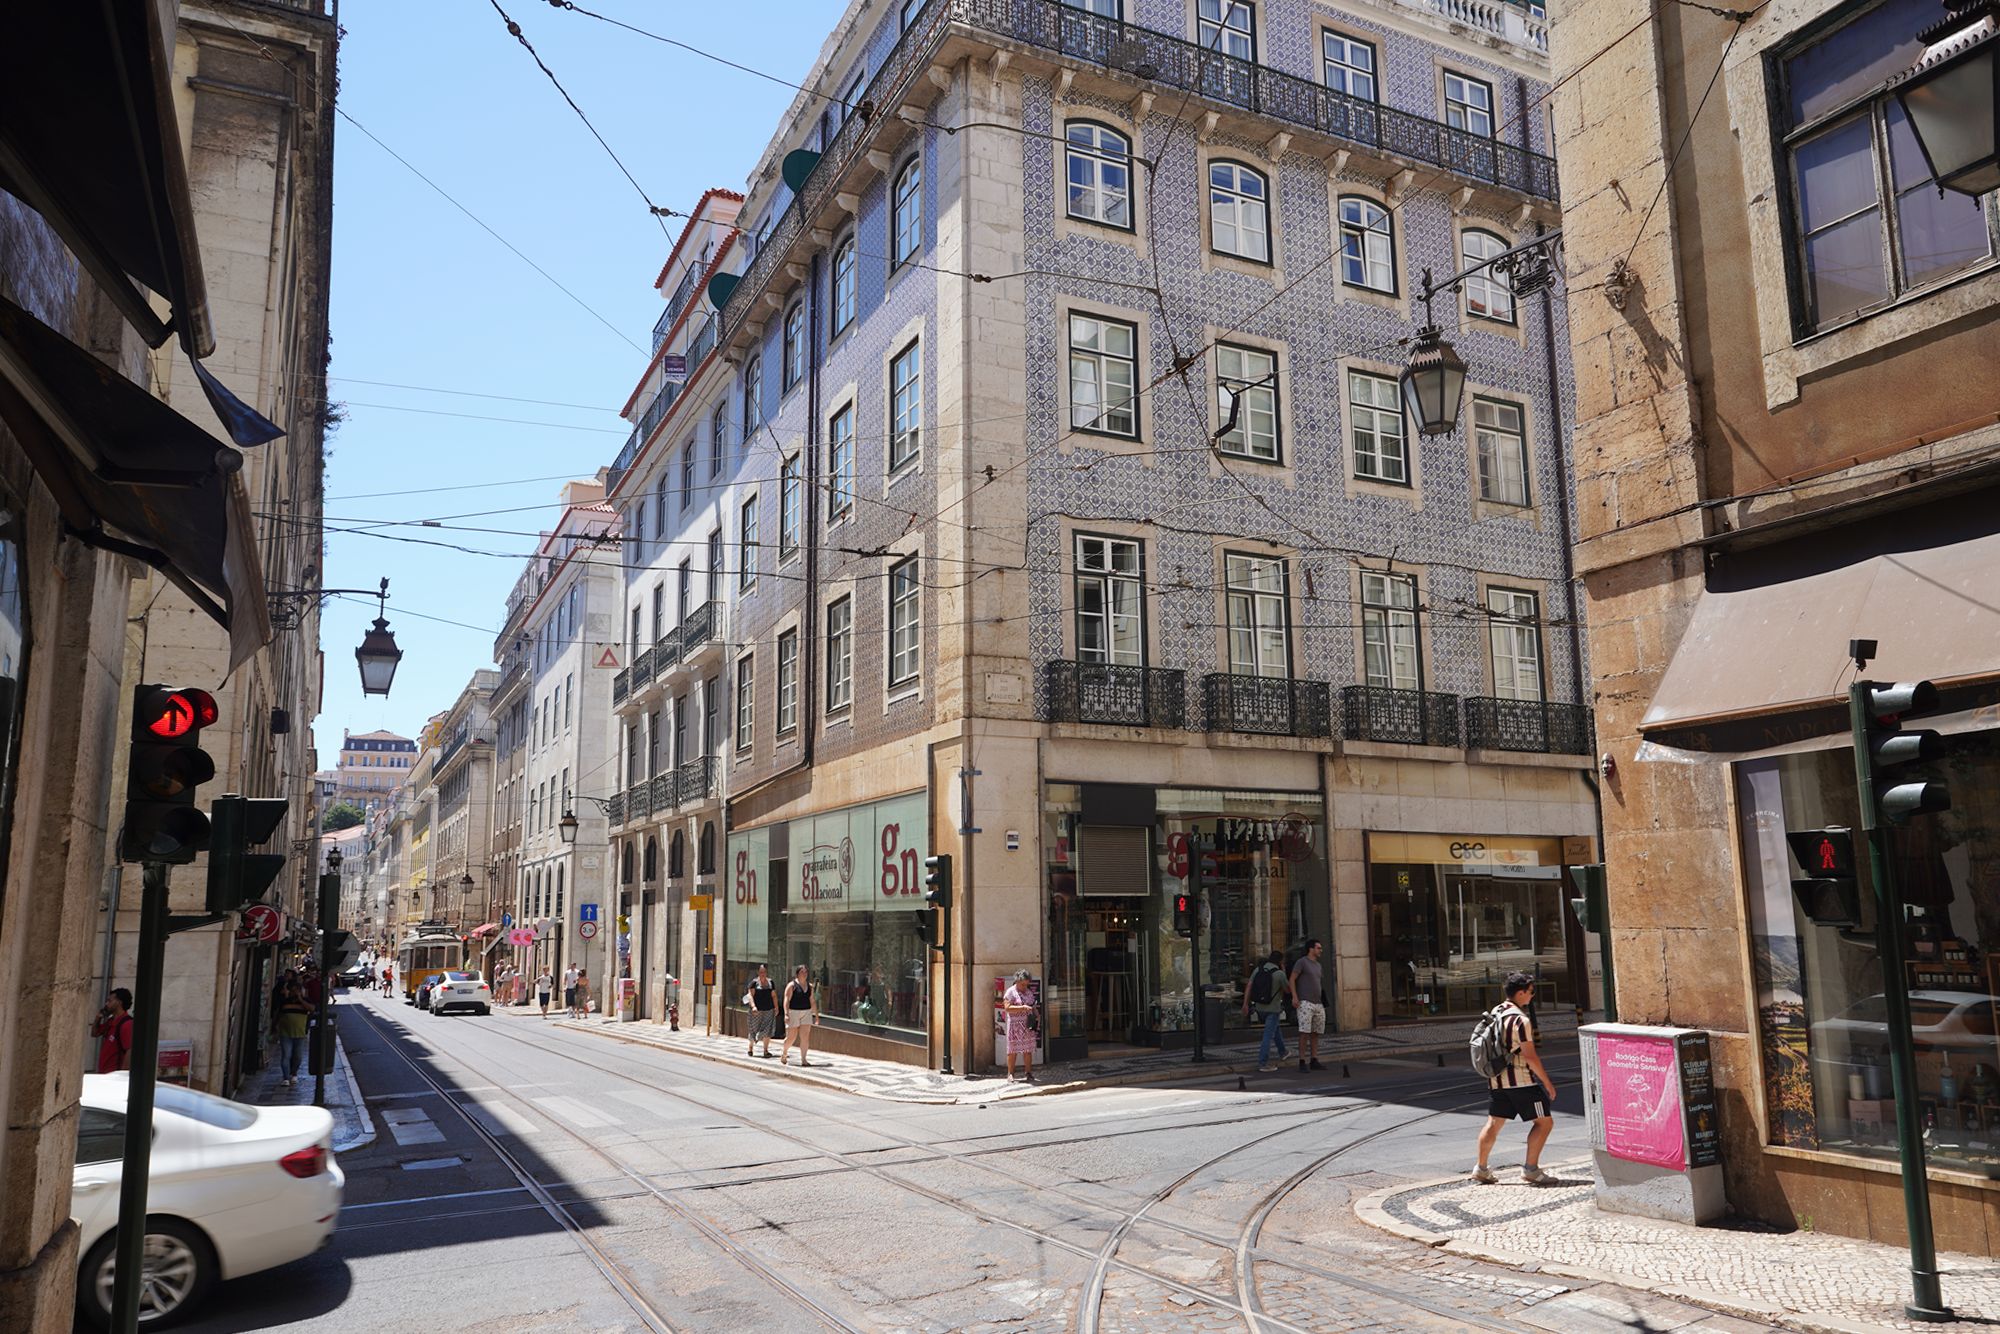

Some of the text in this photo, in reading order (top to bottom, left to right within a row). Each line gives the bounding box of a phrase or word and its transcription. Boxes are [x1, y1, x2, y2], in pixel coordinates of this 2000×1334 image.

[881, 823, 920, 896] gn
[735, 850, 757, 905] gn
[1607, 1060, 1639, 1069] Geometria
[1615, 1052, 1640, 1062] Rodrigo
